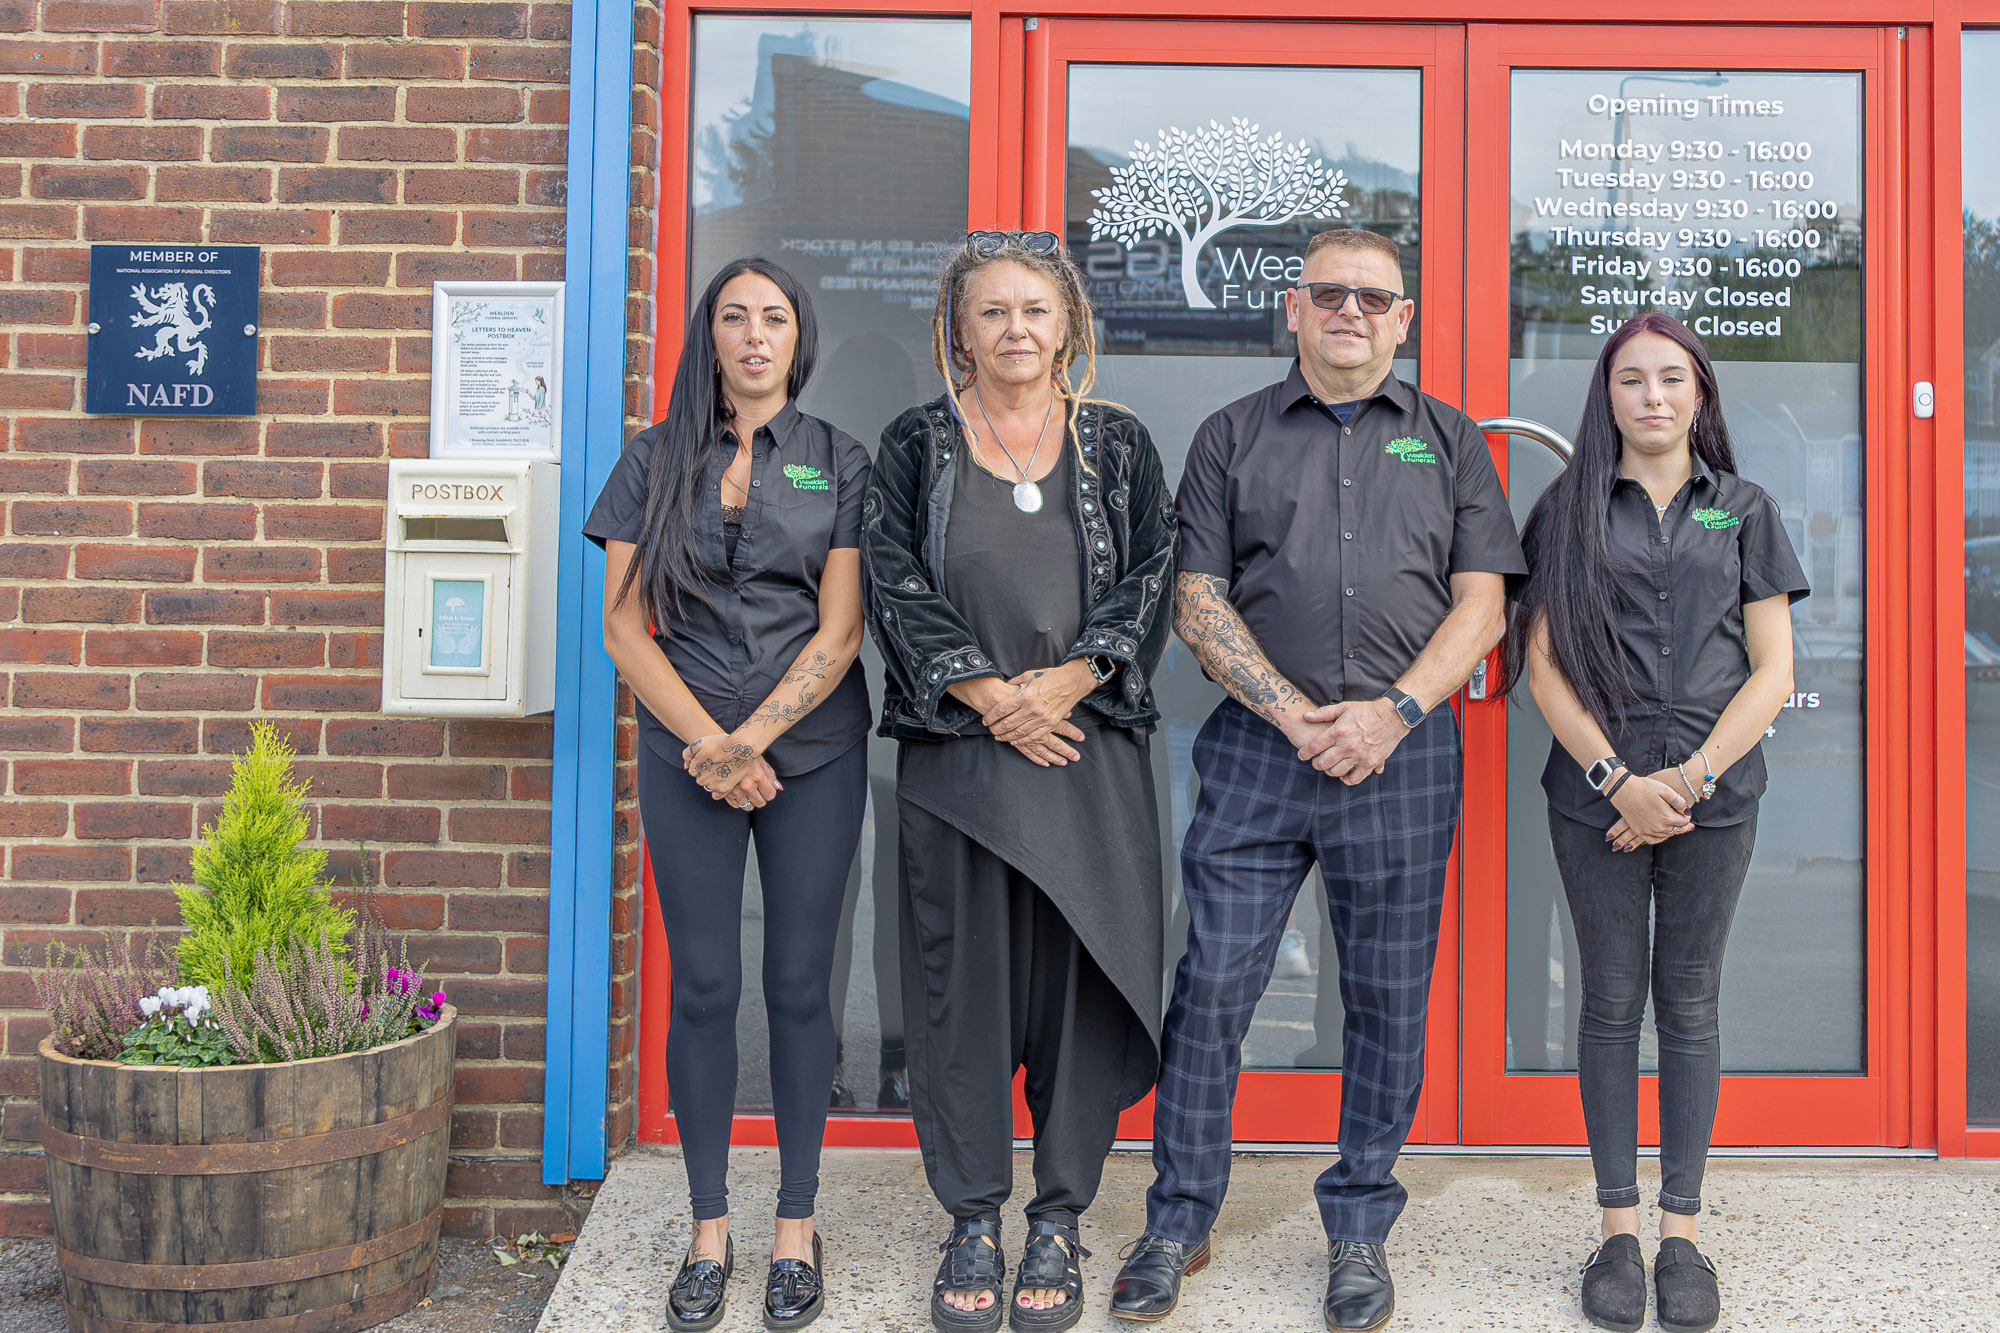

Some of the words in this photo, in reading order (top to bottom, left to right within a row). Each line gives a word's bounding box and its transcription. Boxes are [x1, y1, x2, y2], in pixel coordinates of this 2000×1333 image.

[1588, 93, 1699, 118] Opening
[1707, 94, 1785, 115] Times
[1560, 138, 1664, 163] Monday
[1670, 140, 1723, 159] 9:30
[1748, 141, 1812, 160] 16:00
[1557, 168, 1666, 192] Tuesday
[1672, 169, 1726, 189] 9:30
[1750, 170, 1814, 190] 16:00
[1535, 197, 1688, 222] Wednesday
[1695, 199, 1749, 218] 9:30
[1772, 200, 1838, 219] 16:00
[1551, 226, 1671, 251] Thursday
[1678, 228, 1731, 247] 9:30
[1755, 229, 1821, 248] 16:00
[130, 251, 194, 262] MEMBER
[198, 251, 219, 263] OF
[1571, 255, 1652, 280] Friday
[1658, 257, 1712, 277] 9:30
[1735, 258, 1801, 278] 16:00
[1580, 285, 1697, 311] Saturday
[1704, 286, 1791, 307] Closed
[1694, 315, 1782, 336] Closed
[126, 383, 214, 407] NAFD
[412, 484, 504, 501] POSTBOX
[1782, 692, 1821, 708] urs
